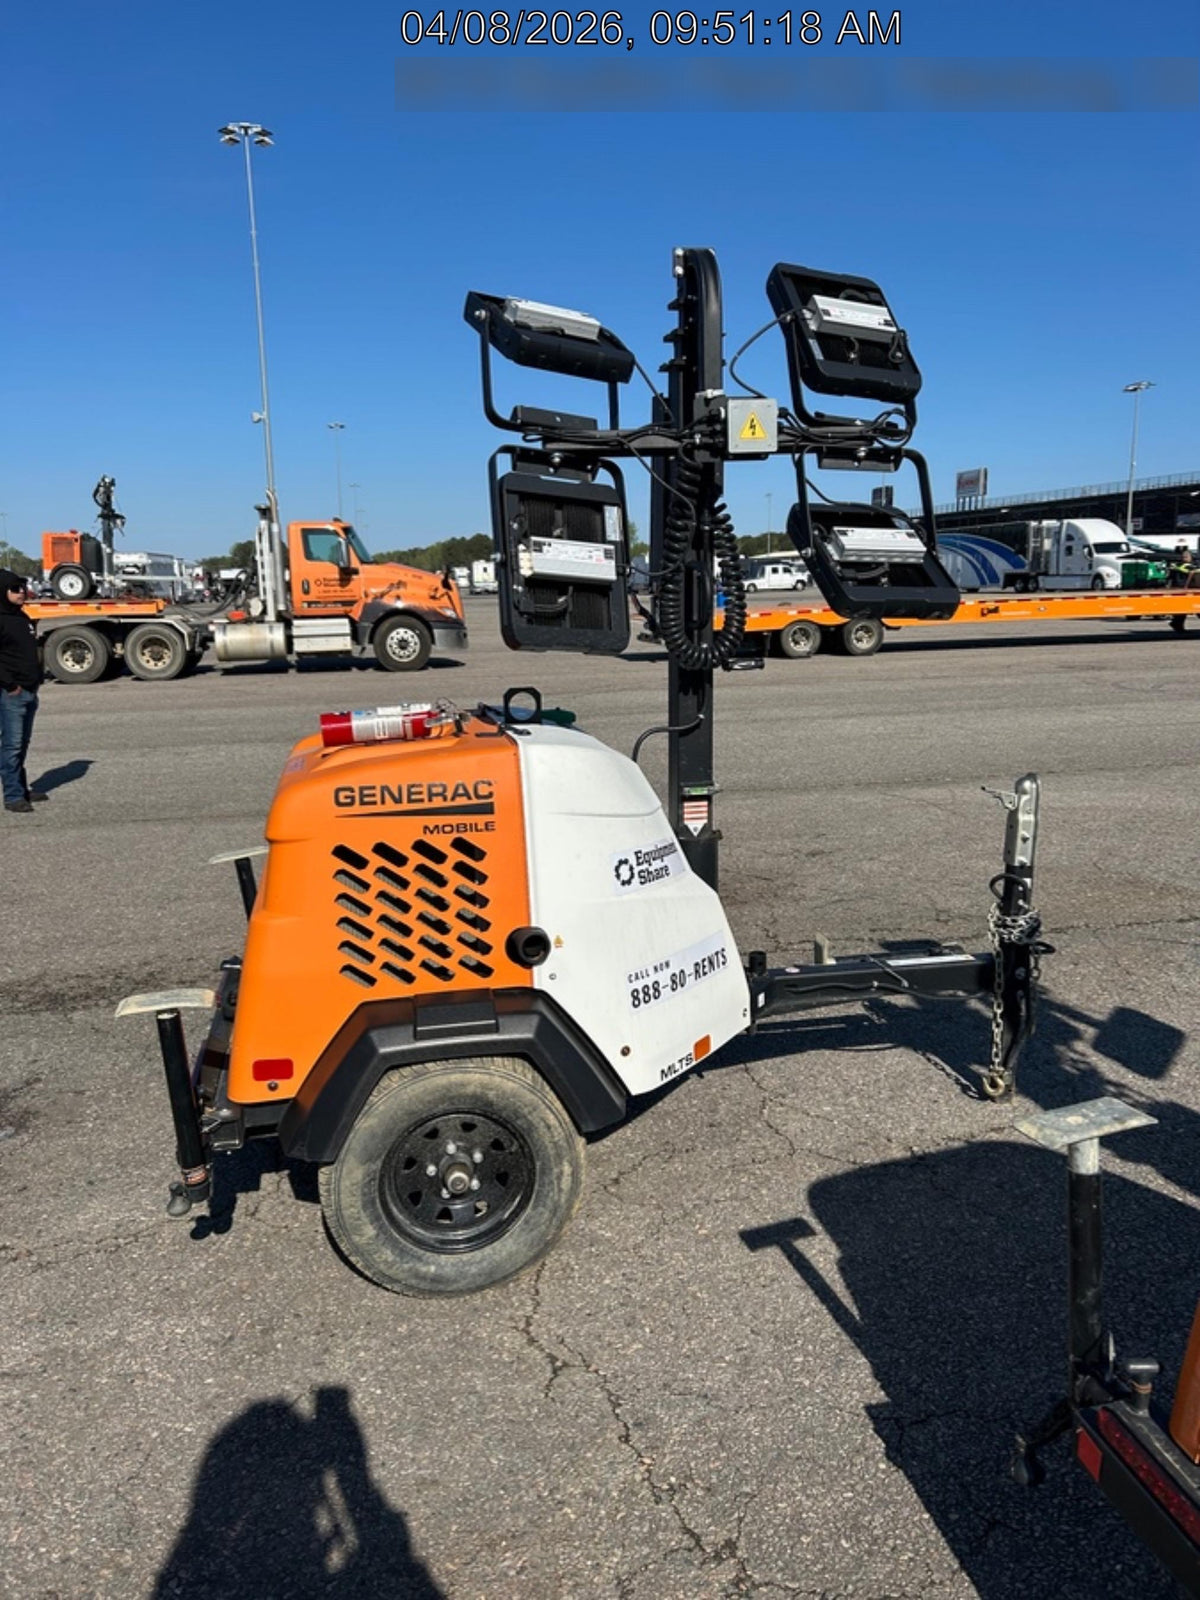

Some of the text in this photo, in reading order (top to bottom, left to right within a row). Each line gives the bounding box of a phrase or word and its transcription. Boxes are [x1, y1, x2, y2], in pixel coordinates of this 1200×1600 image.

[333, 780, 494, 808] GENERAC
[422, 821, 496, 835] MOBILE
[637, 865, 671, 886] Share
[627, 960, 670, 983] CALL NOW
[630, 947, 728, 1009] 888-80-RENTS
[660, 1052, 693, 1081] MLTS
